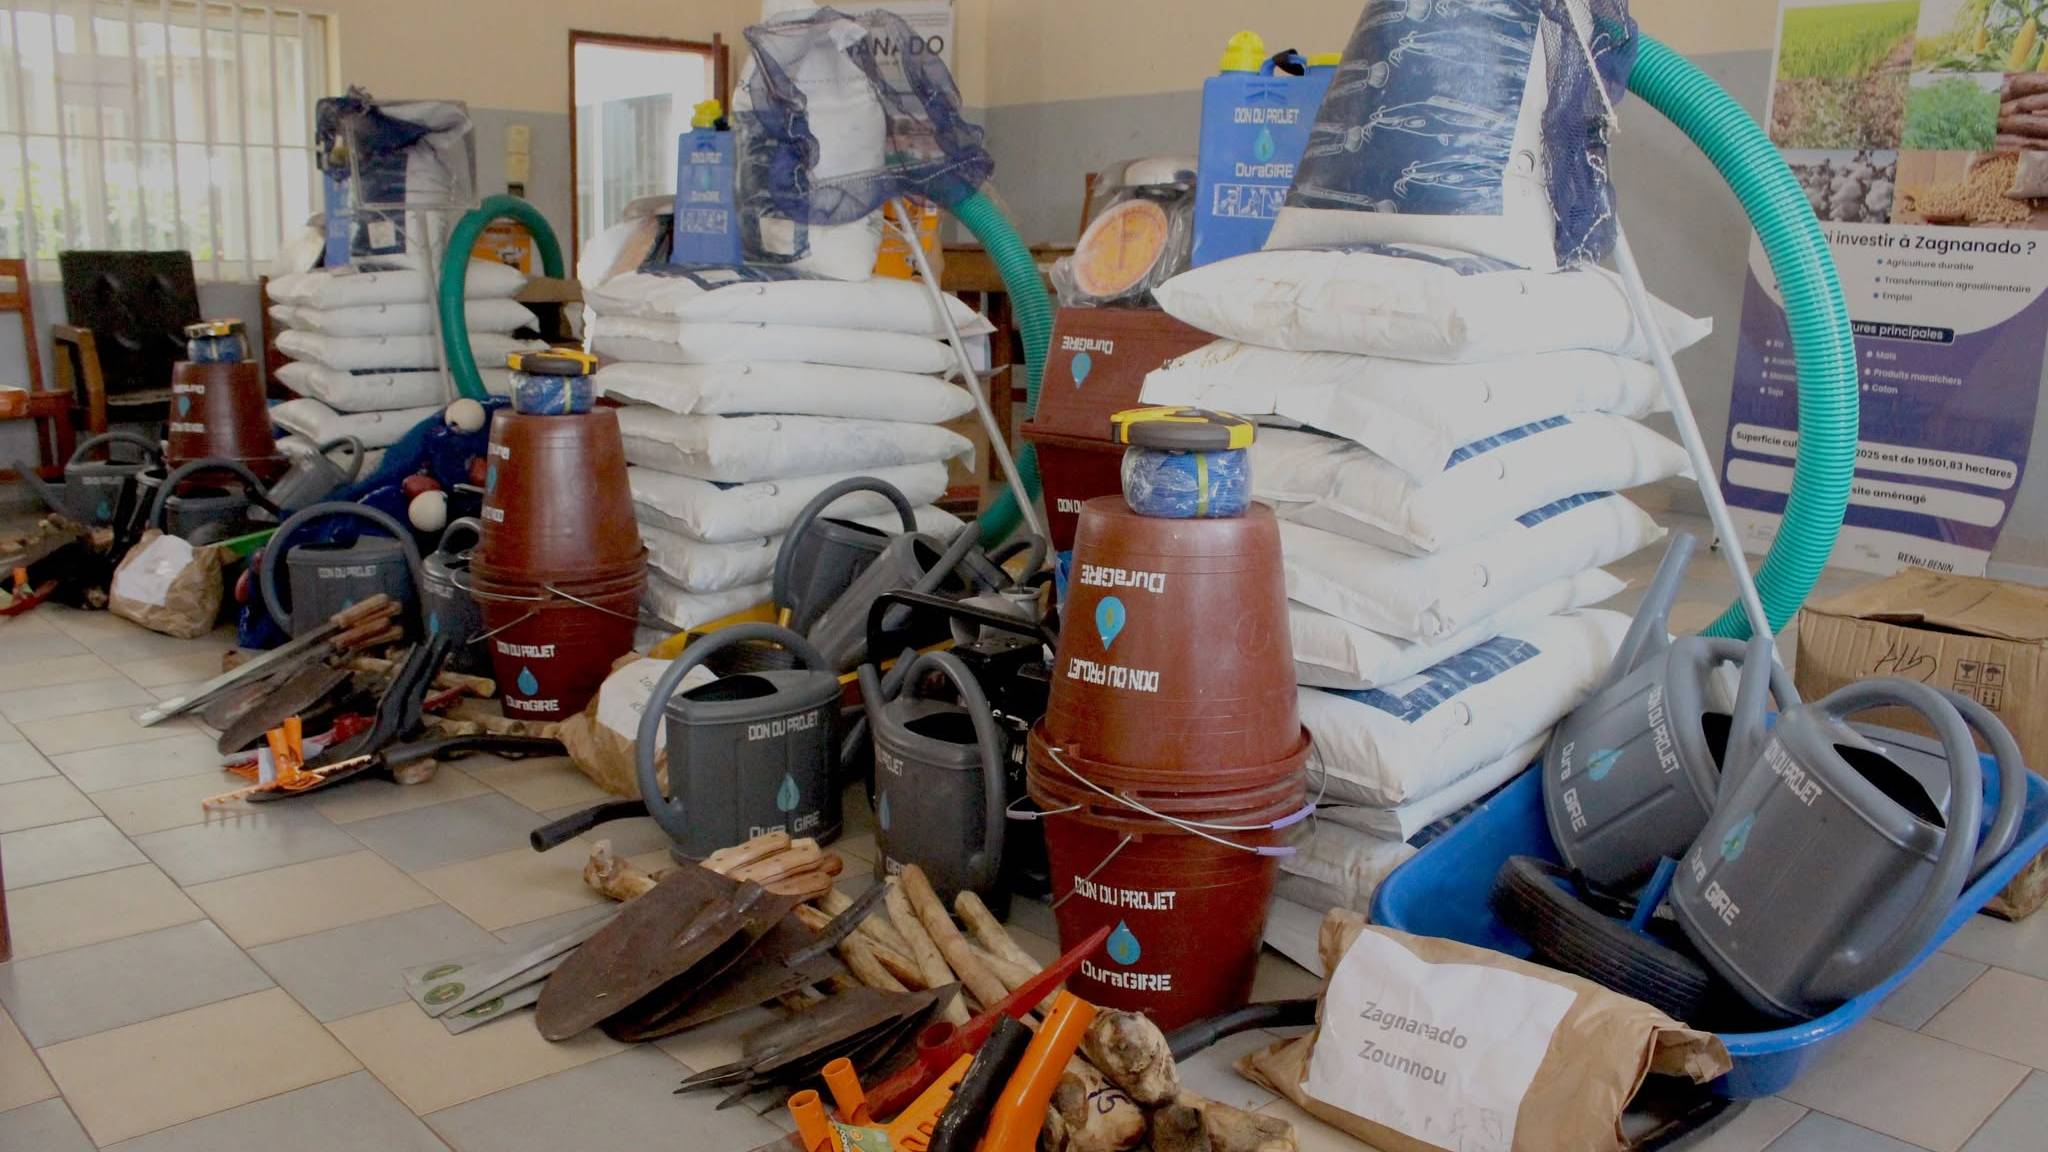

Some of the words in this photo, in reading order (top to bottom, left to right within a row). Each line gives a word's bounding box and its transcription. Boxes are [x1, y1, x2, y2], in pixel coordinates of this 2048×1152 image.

[1234, 108, 1251, 124] DON
[1252, 108, 1265, 124] DU
[1266, 108, 1300, 124] PROJET
[1235, 162, 1294, 178] DuraGIRE
[1836, 230, 1895, 247] investir
[1915, 235, 2022, 257] Zagnanado
[2027, 240, 2037, 255] ?
[1886, 257, 1936, 269] Agriculture
[1938, 260, 1974, 271] durable
[1882, 291, 1913, 303] Emploi
[1884, 275, 1954, 289] Transformation
[1955, 280, 2031, 294] agroalimentaire
[1851, 322, 1877, 333] ures
[1879, 324, 1943, 340] principales
[1062, 336, 1113, 355] DuraGIRE
[1874, 367, 1909, 380] Produits
[1736, 431, 1781, 446] Superficie
[1855, 448, 1880, 461] 2025
[1881, 452, 1899, 463] est
[1901, 453, 1915, 465] de
[1916, 456, 1963, 472] 19501,83
[1964, 460, 2013, 479] hectares
[1852, 486, 1871, 497] site
[1873, 487, 1927, 504] aménagé
[1080, 564, 1167, 593] DuraGIRE
[1067, 657, 1106, 686] PROJET
[1107, 664, 1128, 687] DU
[1127, 670, 1160, 693] DON
[748, 722, 771, 742] DON
[772, 719, 786, 737] DU
[786, 710, 819, 733] PROJET
[1652, 718, 1680, 774] PROJET
[1781, 762, 1823, 806] PROJET
[793, 810, 821, 833] GIRE
[1562, 788, 1587, 833] GIRE
[1074, 875, 1098, 902] DON
[1099, 884, 1118, 906] DU
[1120, 889, 1177, 911] PROJET
[1704, 880, 1741, 927] GIRE
[1081, 959, 1172, 992] DuraGIRE
[1359, 1000, 1469, 1051] Zagnanado
[1357, 1039, 1449, 1087] Zounnou
